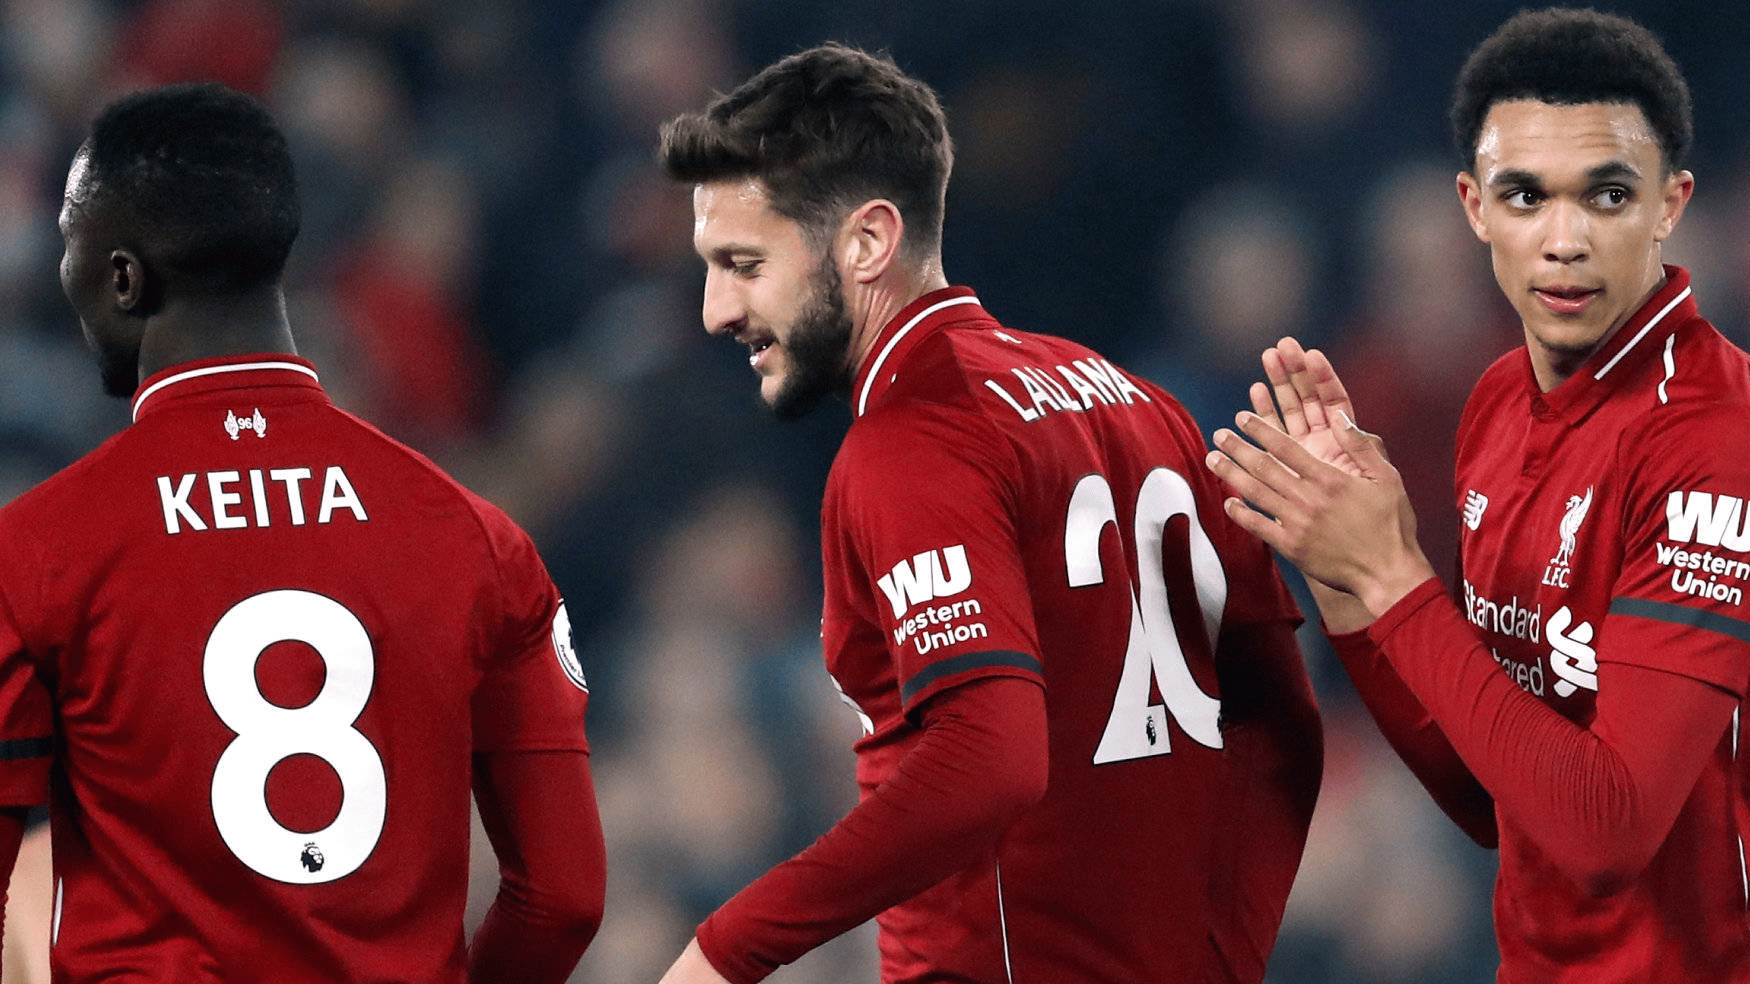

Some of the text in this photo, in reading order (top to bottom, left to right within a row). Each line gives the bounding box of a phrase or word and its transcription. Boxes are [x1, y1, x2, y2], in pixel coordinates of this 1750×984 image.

[237, 417, 253, 430] 96
[157, 465, 368, 535] KEITA
[876, 544, 973, 620] WU
[1656, 542, 1750, 580] Western
[1671, 569, 1743, 606] Union
[893, 599, 982, 646] Western
[913, 622, 989, 655] Union
[1065, 467, 1227, 765] 20
[202, 589, 388, 885] 8
